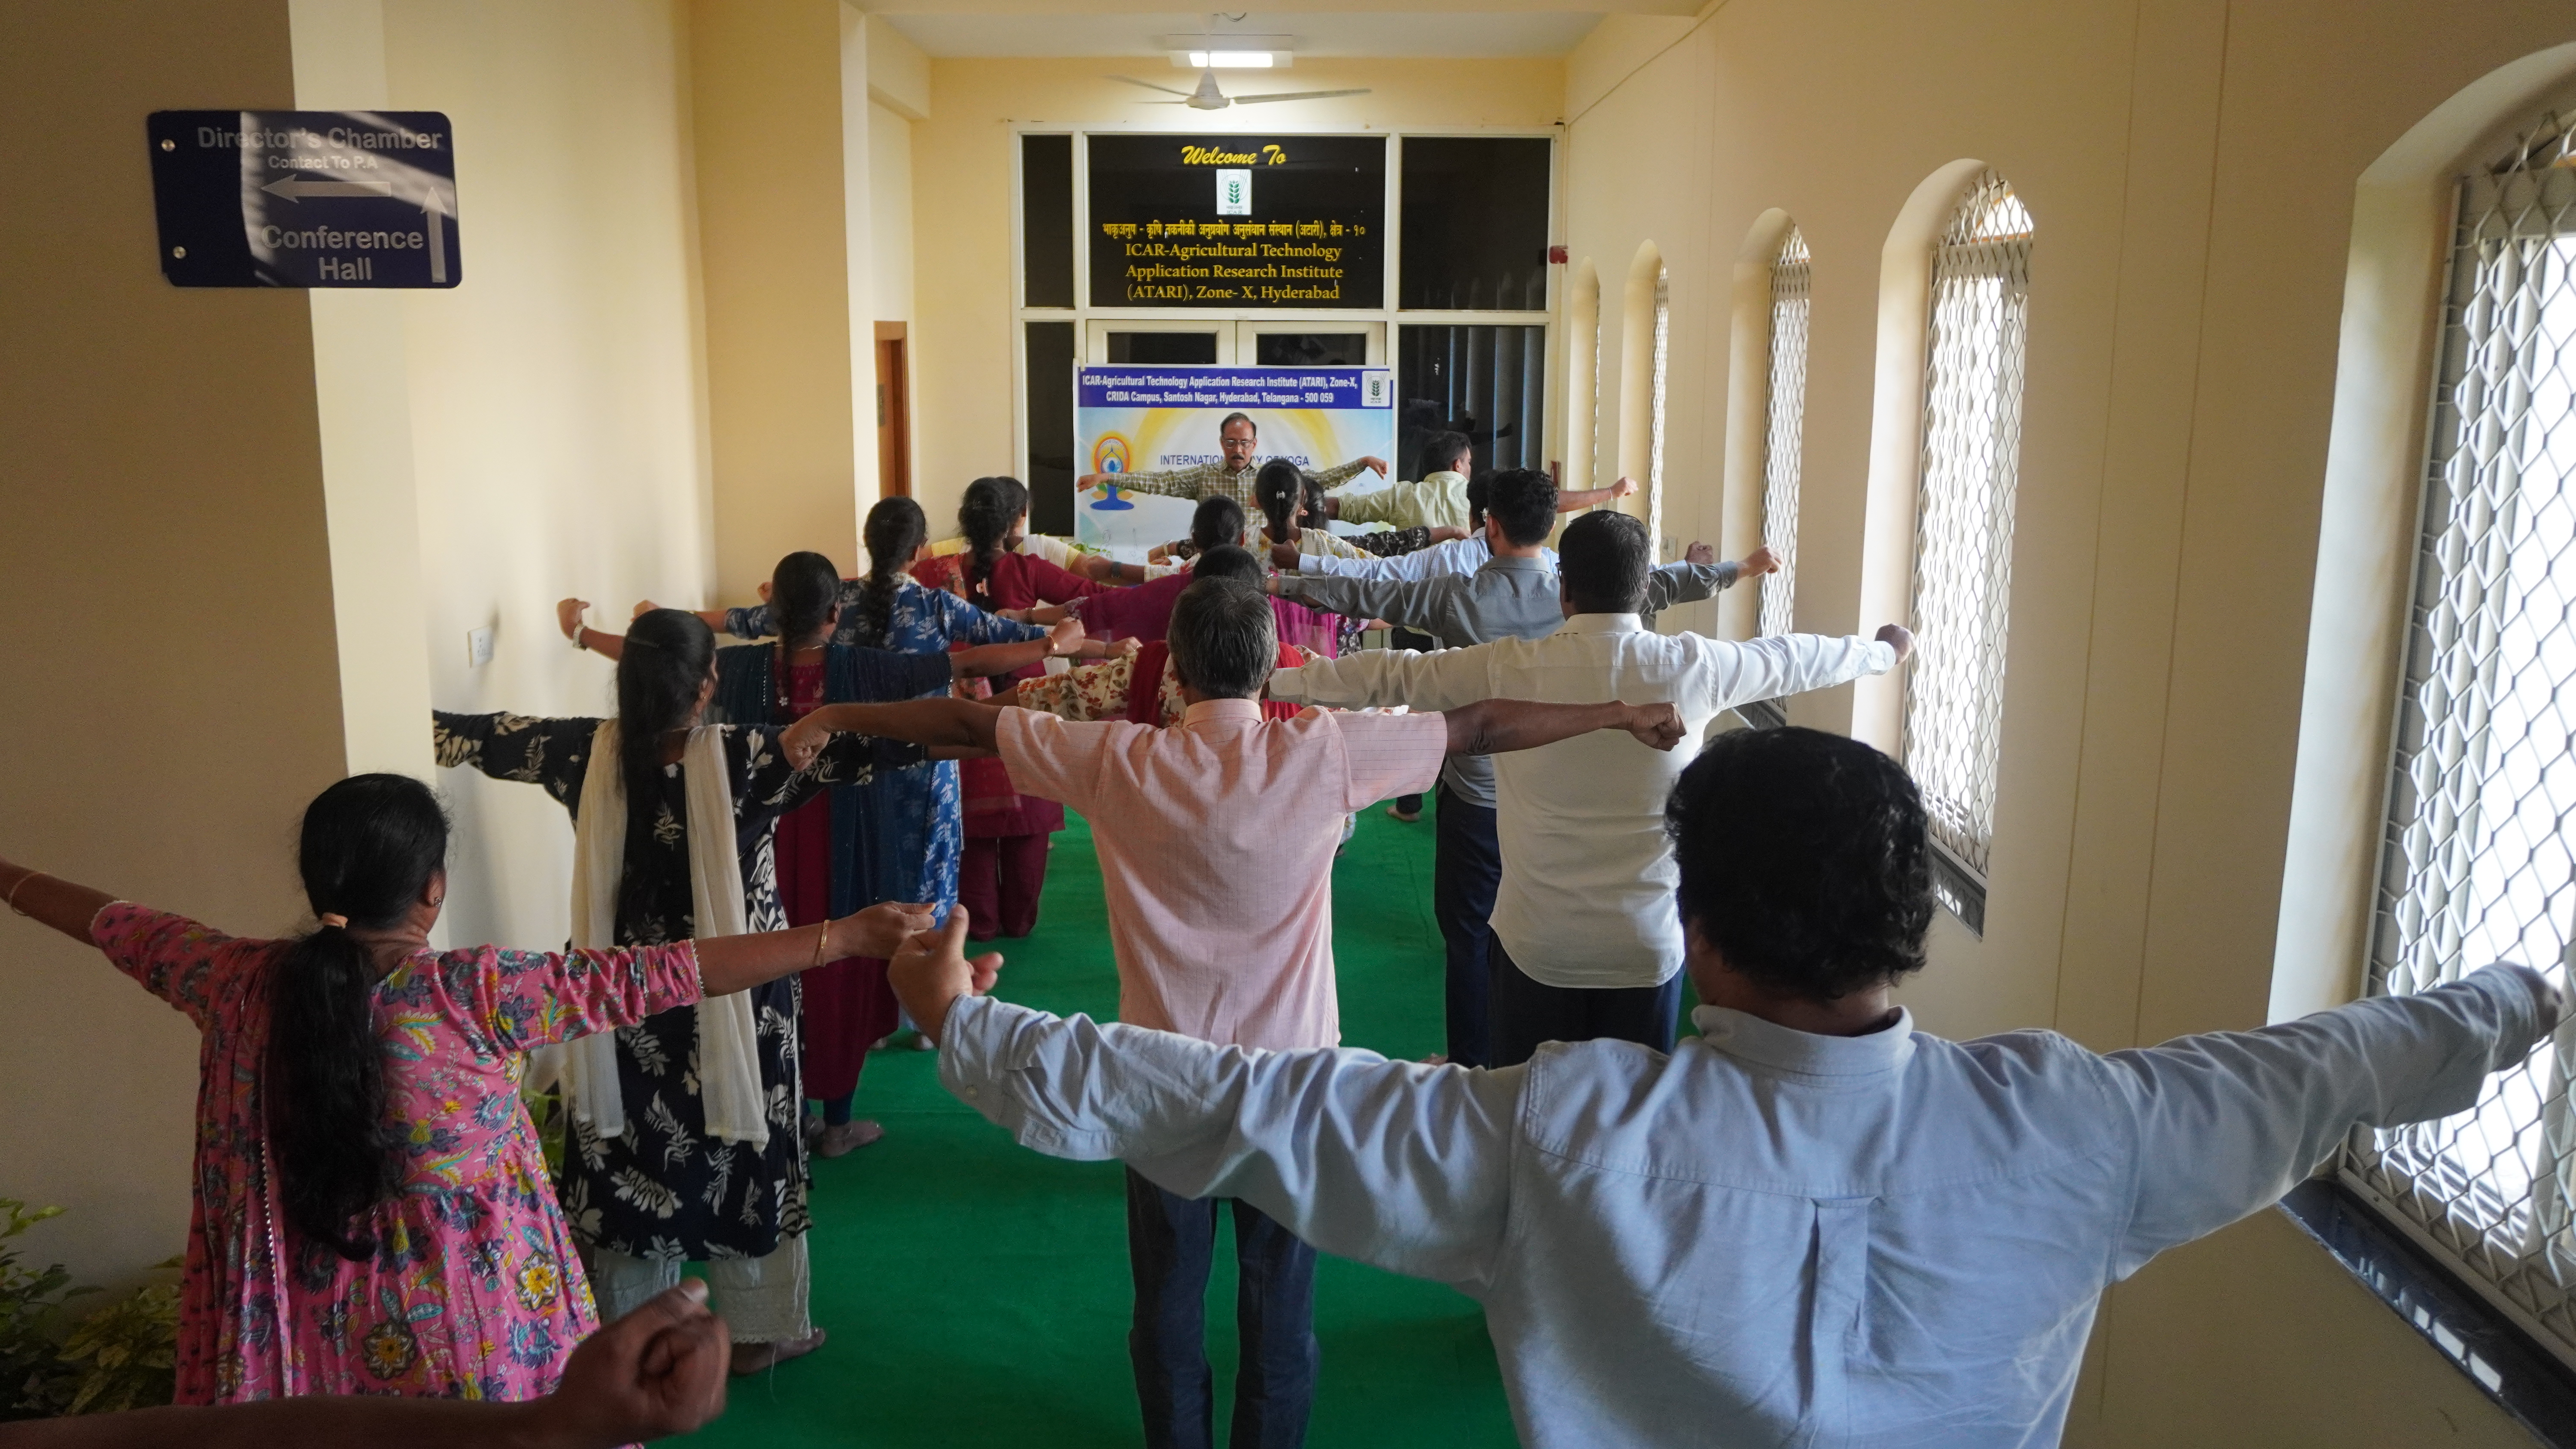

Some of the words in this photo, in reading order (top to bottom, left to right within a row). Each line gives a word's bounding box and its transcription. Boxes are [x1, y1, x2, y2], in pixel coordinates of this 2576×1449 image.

[197, 127, 322, 149] Director's
[328, 127, 443, 149] Chamber
[268, 155, 329, 169] Contact
[331, 156, 350, 169] To
[353, 156, 378, 170] P.A
[1182, 145, 1258, 164] Welcome
[1263, 144, 1287, 166] To
[261, 224, 424, 249] Conference
[1103, 223, 1137, 239] भाकृअनुप
[1146, 219, 1163, 239] कृषि
[1165, 219, 1195, 236] तकनीकी
[1198, 219, 1230, 239] अनुप्रयोग
[1233, 220, 1266, 239] अनुसंधान
[1268, 220, 1294, 236] संस्थान
[1330, 219, 1343, 236] क्षेत्र
[1125, 241, 1257, 261] ICAR-Agricultural
[1261, 243, 1342, 261] Technology
[319, 257, 373, 281] Hall
[1125, 264, 1210, 281] Application
[1213, 264, 1278, 278] Research
[1281, 265, 1343, 279] Institute
[1127, 283, 1193, 301] (ATARI),
[1196, 285, 1238, 298] Zone-
[1242, 286, 1258, 300] X,
[1261, 285, 1341, 303] Hyderabad
[1082, 375, 1145, 388] ICAR-Agricultural
[1146, 376, 1188, 389] Technology
[1189, 376, 1230, 388] Application
[1231, 376, 1265, 387] Research
[1267, 376, 1297, 387] Institute
[1299, 376, 1328, 389] (ATARI),
[1329, 377, 1358, 390] Zone-X,
[1106, 391, 1130, 402] CRIDA
[1131, 391, 1163, 404] Campus,
[1163, 391, 1193, 403] Santosh
[1194, 391, 1218, 404] Nagar,
[1219, 392, 1260, 405] Hyderabad,
[1261, 392, 1299, 405] Telangana
[1305, 392, 1318, 403] 500
[1320, 392, 1334, 403] 059
[1160, 455, 1224, 465] INTERNATIO
